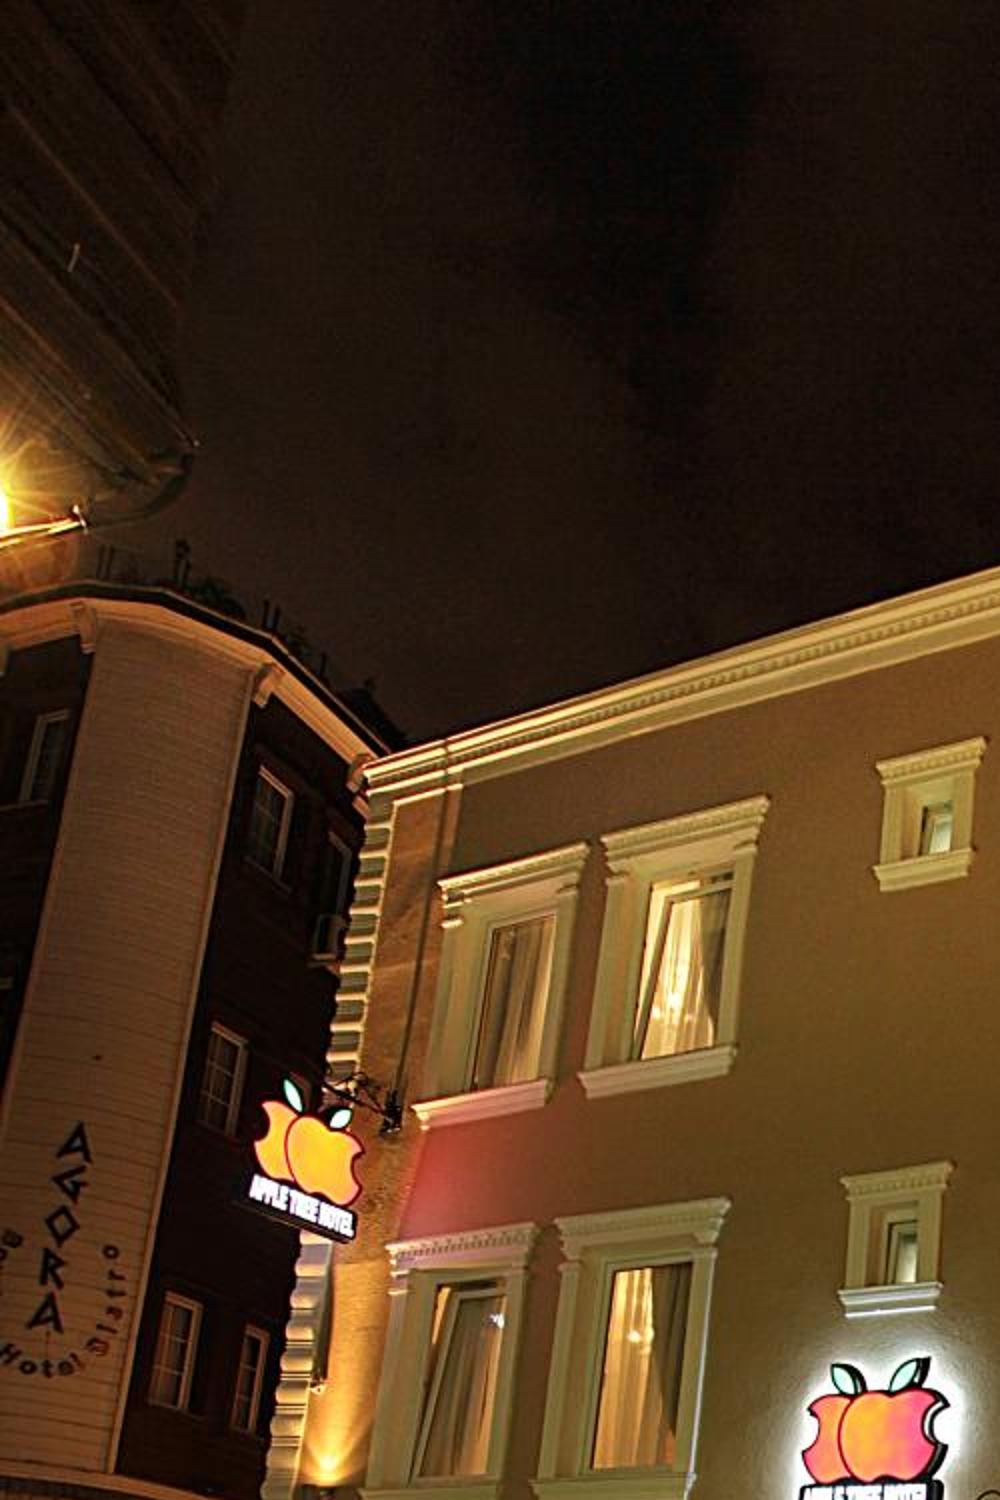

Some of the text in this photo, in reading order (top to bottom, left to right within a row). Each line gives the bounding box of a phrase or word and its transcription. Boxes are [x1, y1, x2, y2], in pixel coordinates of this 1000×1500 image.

[26, 1120, 93, 1334] AGORA
[249, 1174, 354, 1238] APPLE TREE HOTEL
